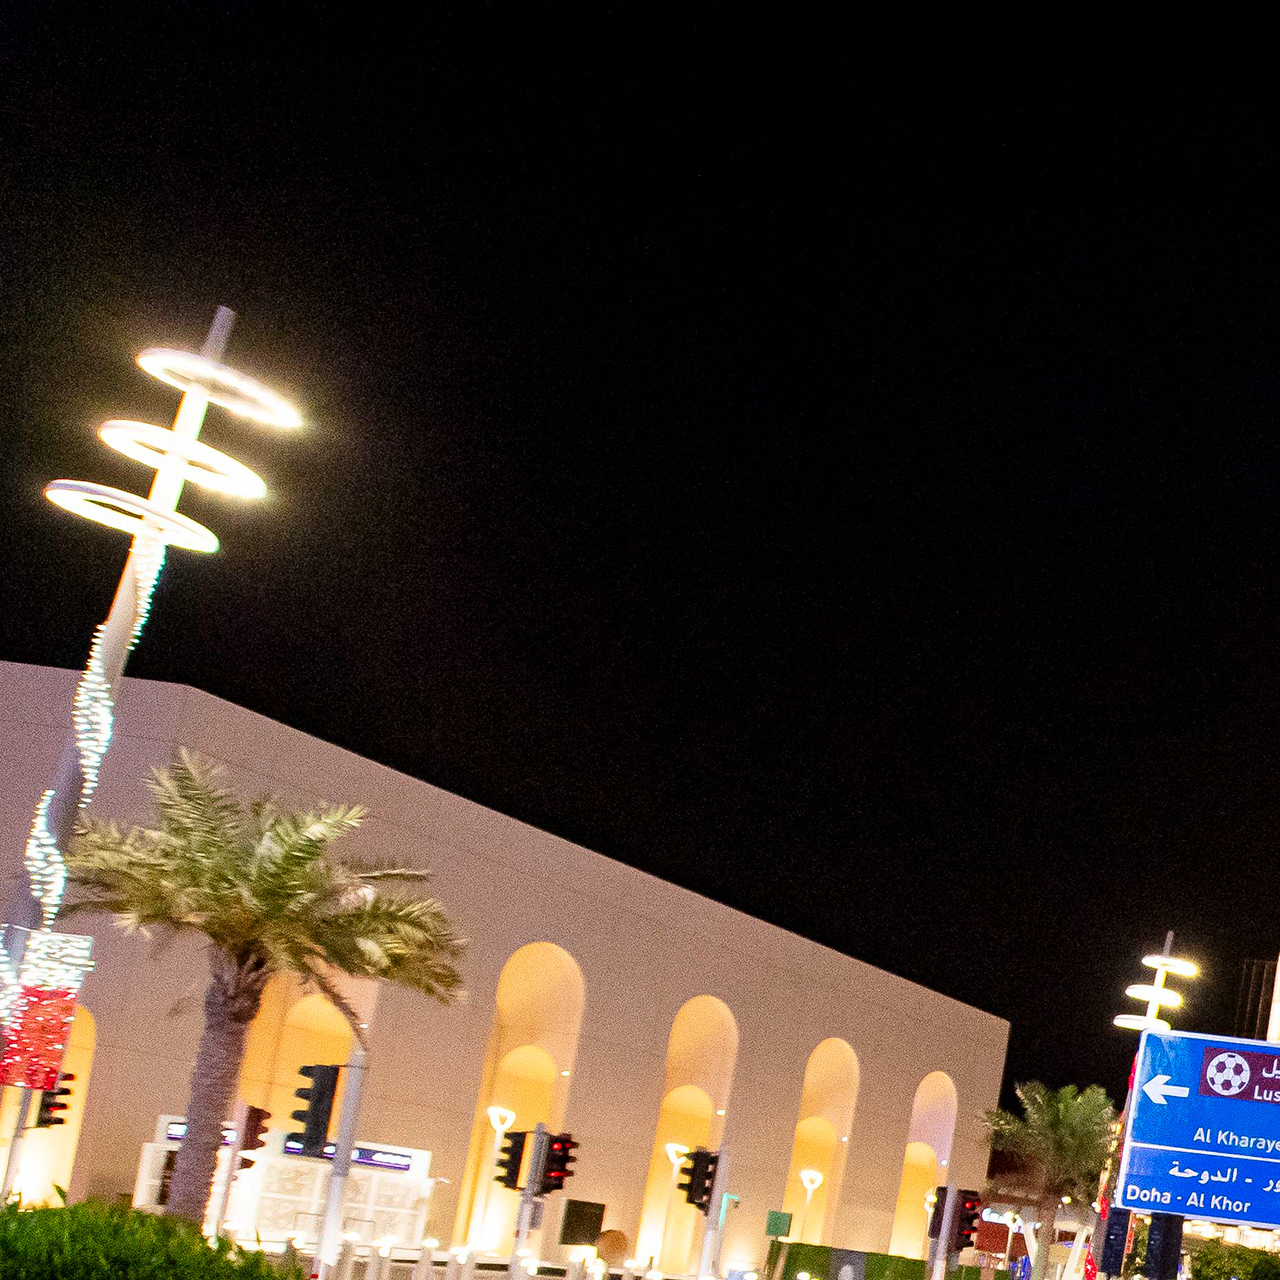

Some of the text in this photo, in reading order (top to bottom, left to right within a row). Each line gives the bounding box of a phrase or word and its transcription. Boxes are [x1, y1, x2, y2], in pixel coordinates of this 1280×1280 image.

[1193, 1128, 1212, 1142] Al
[1168, 1160, 1238, 1186] الدوحة
[1126, 1185, 1172, 1204] Doha
[1186, 1193, 1206, 1208] Al
[1210, 1195, 1251, 1214] Khor
